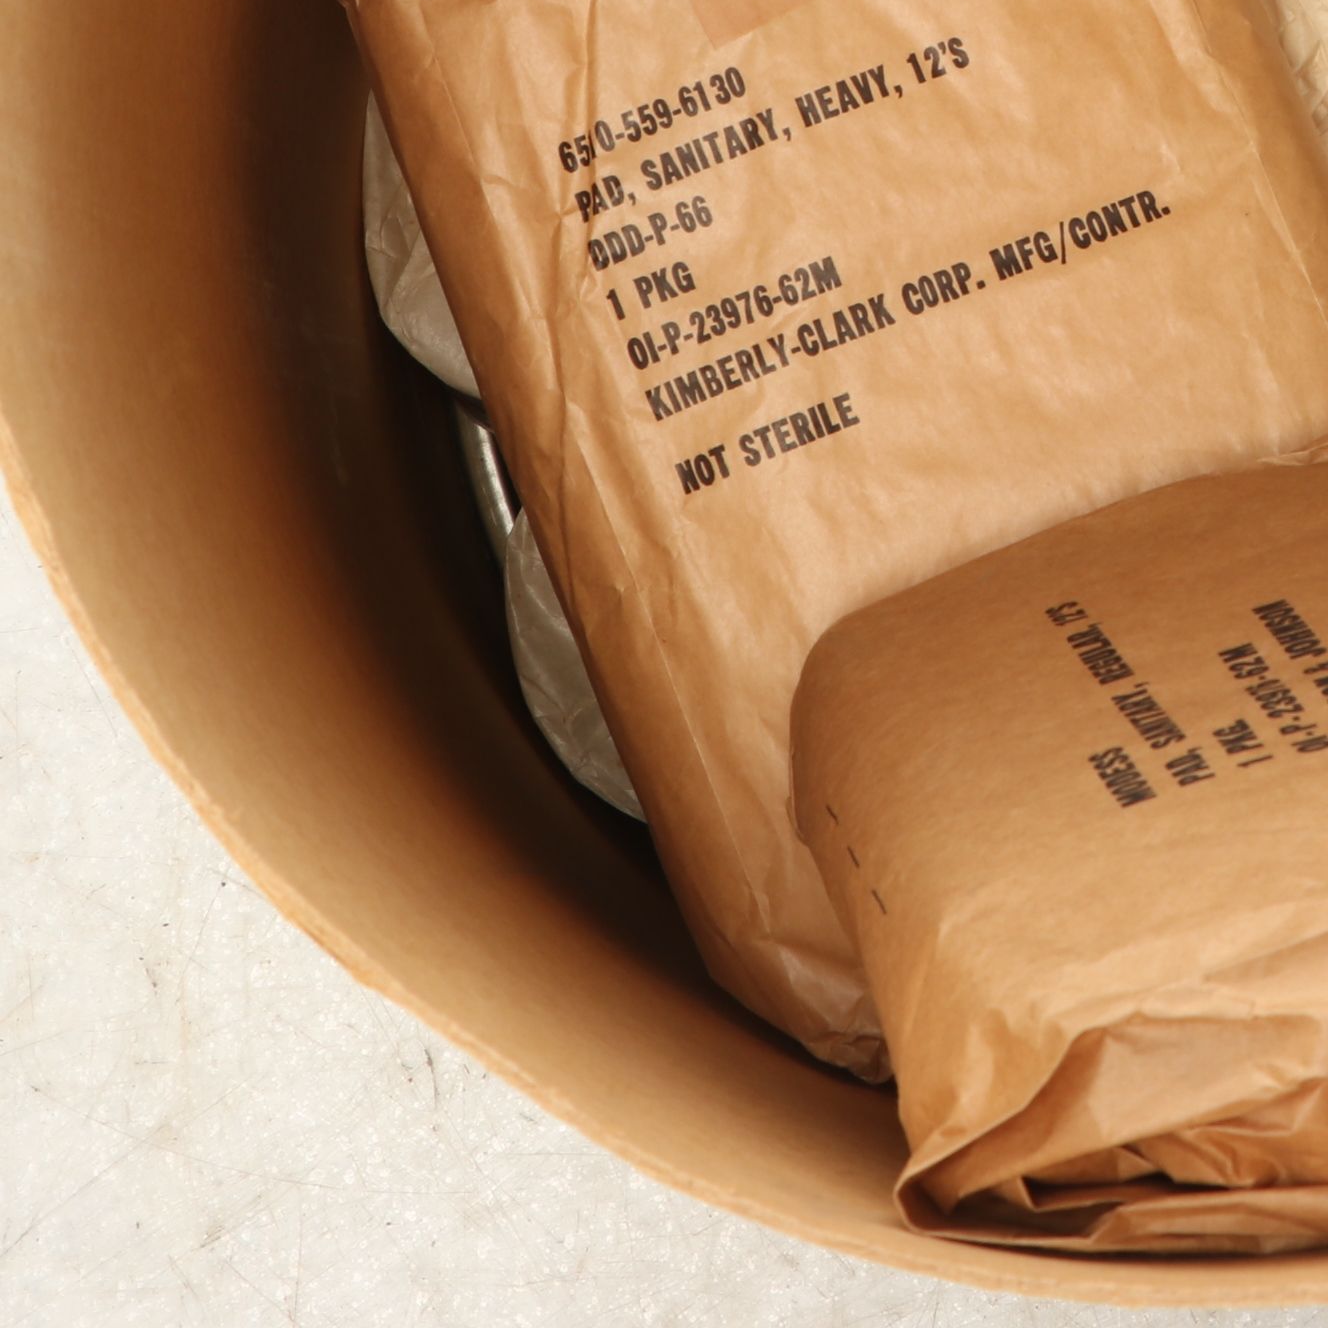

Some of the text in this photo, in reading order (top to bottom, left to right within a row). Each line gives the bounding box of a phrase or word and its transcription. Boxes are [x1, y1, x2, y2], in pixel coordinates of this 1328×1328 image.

[576, 37, 969, 226] PAD, SANITARY, HEAVY, 12'S
[606, 262, 696, 320] 1 PKG
[646, 191, 1171, 421] KIMBERLY-CLARK CORP. MFG/CONTR.
[675, 394, 860, 495] NOT STERILE
